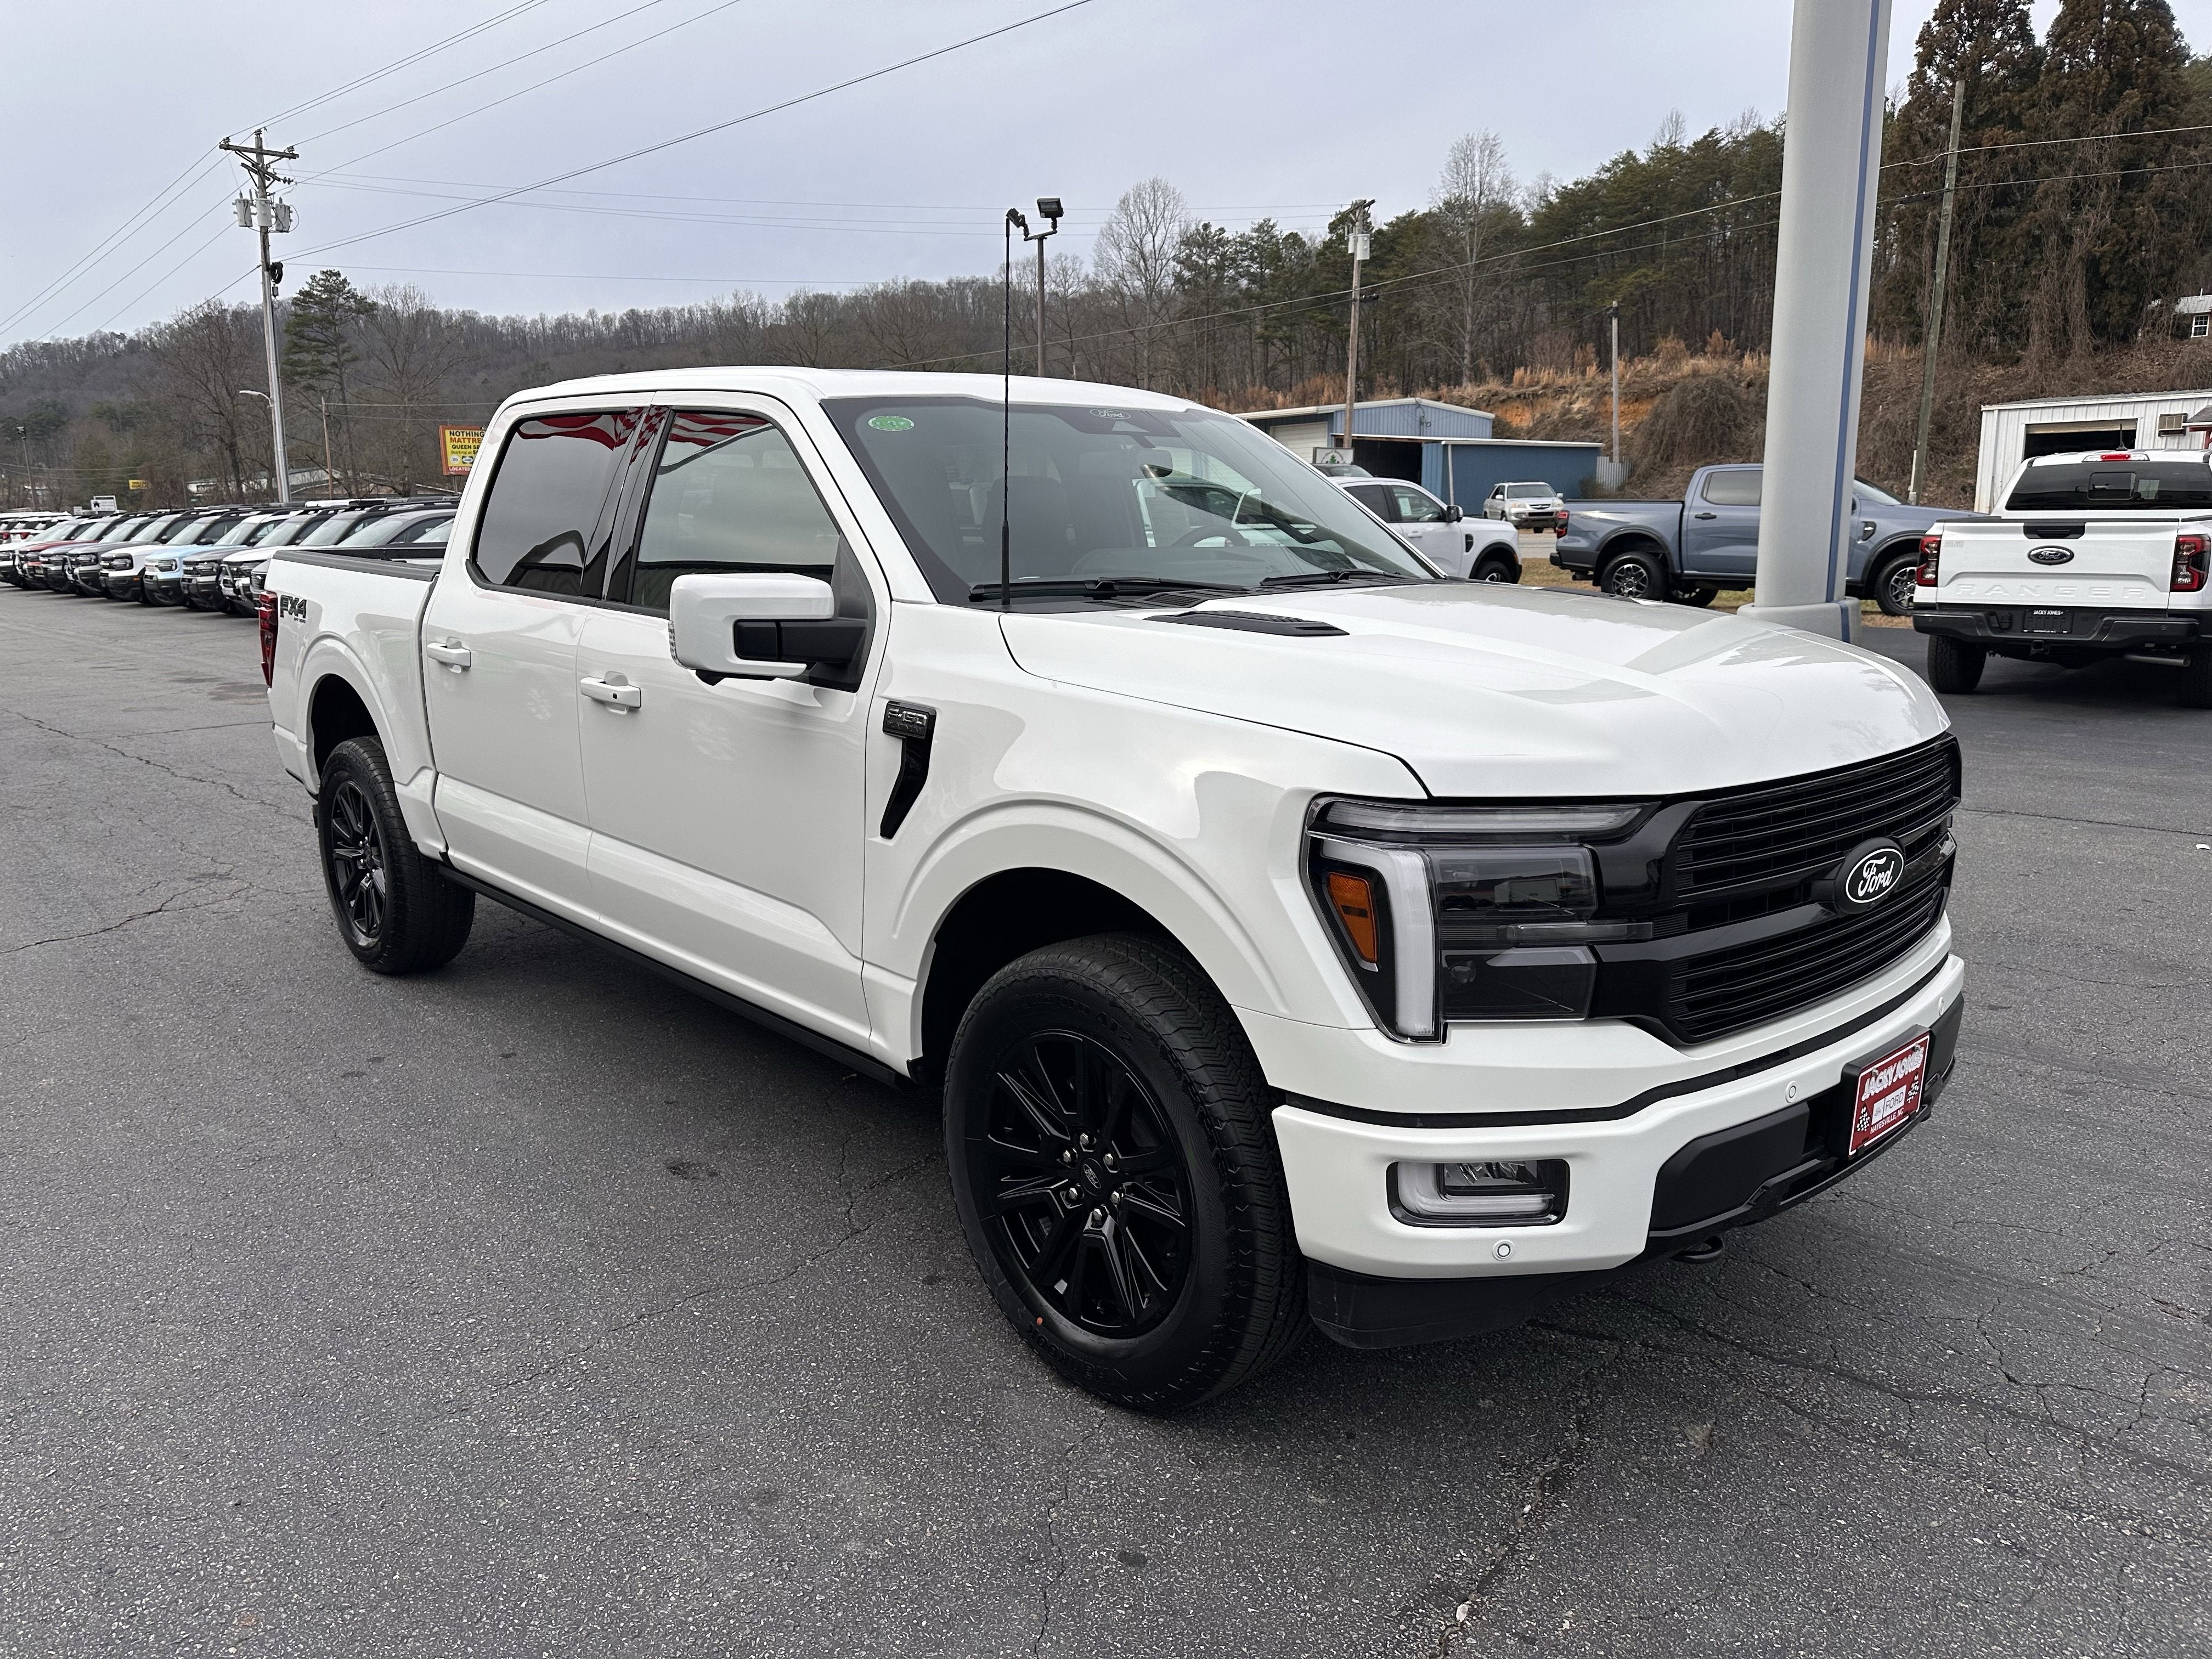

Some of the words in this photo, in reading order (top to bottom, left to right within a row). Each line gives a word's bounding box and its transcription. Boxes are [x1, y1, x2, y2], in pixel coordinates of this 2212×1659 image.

[1098, 409, 1125, 418] Ford
[2039, 550, 2061, 560] Ford
[1955, 583, 2147, 599] RANGER
[280, 595, 307, 619] FX4
[887, 708, 927, 726] F-150
[1857, 856, 1895, 897] Ford
[1861, 1063, 1898, 1102] JACKY
[1894, 1047, 1925, 1082] JONES
[1885, 1092, 1904, 1112] FORD
[1897, 1107, 1904, 1117] NC
